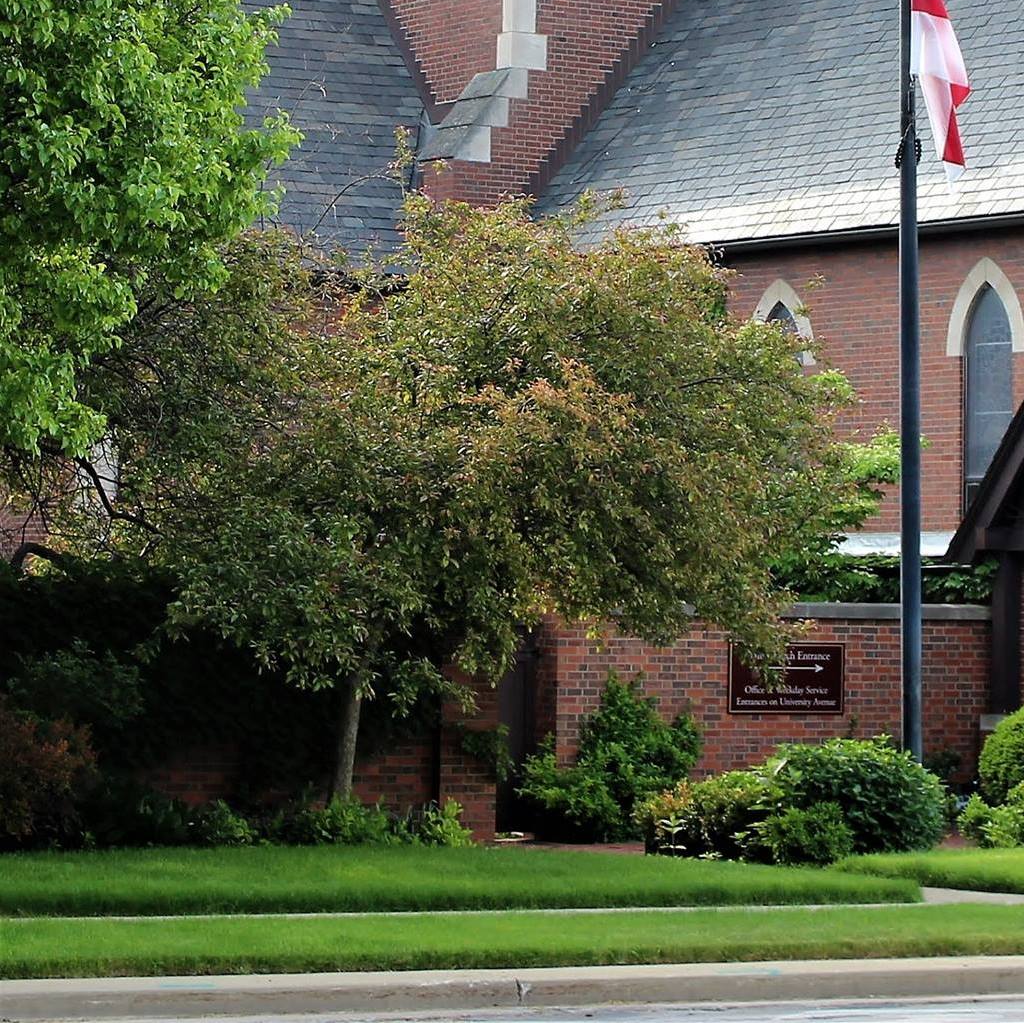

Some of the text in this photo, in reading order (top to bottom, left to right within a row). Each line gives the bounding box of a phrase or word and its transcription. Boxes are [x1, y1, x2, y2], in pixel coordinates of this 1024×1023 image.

[797, 651, 831, 661] Entrance
[744, 685, 765, 695] Office
[806, 685, 828, 694] Service
[736, 697, 837, 708] Entrances on University Avenue
